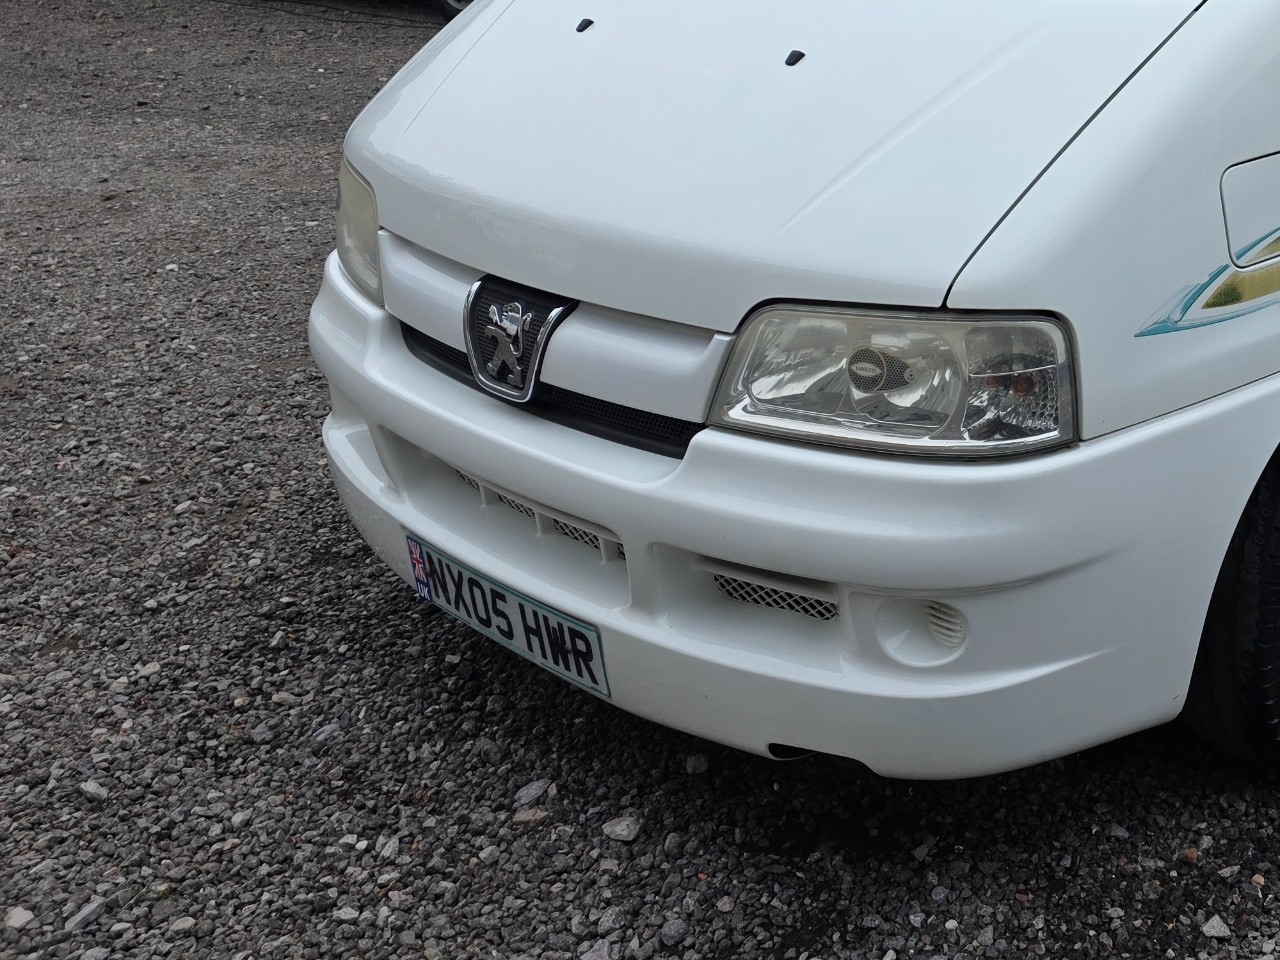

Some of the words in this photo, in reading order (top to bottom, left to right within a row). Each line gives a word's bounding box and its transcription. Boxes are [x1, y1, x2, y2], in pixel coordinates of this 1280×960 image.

[417, 581, 430, 601] UK
[425, 550, 515, 641] NX05
[518, 602, 600, 687] HWR
